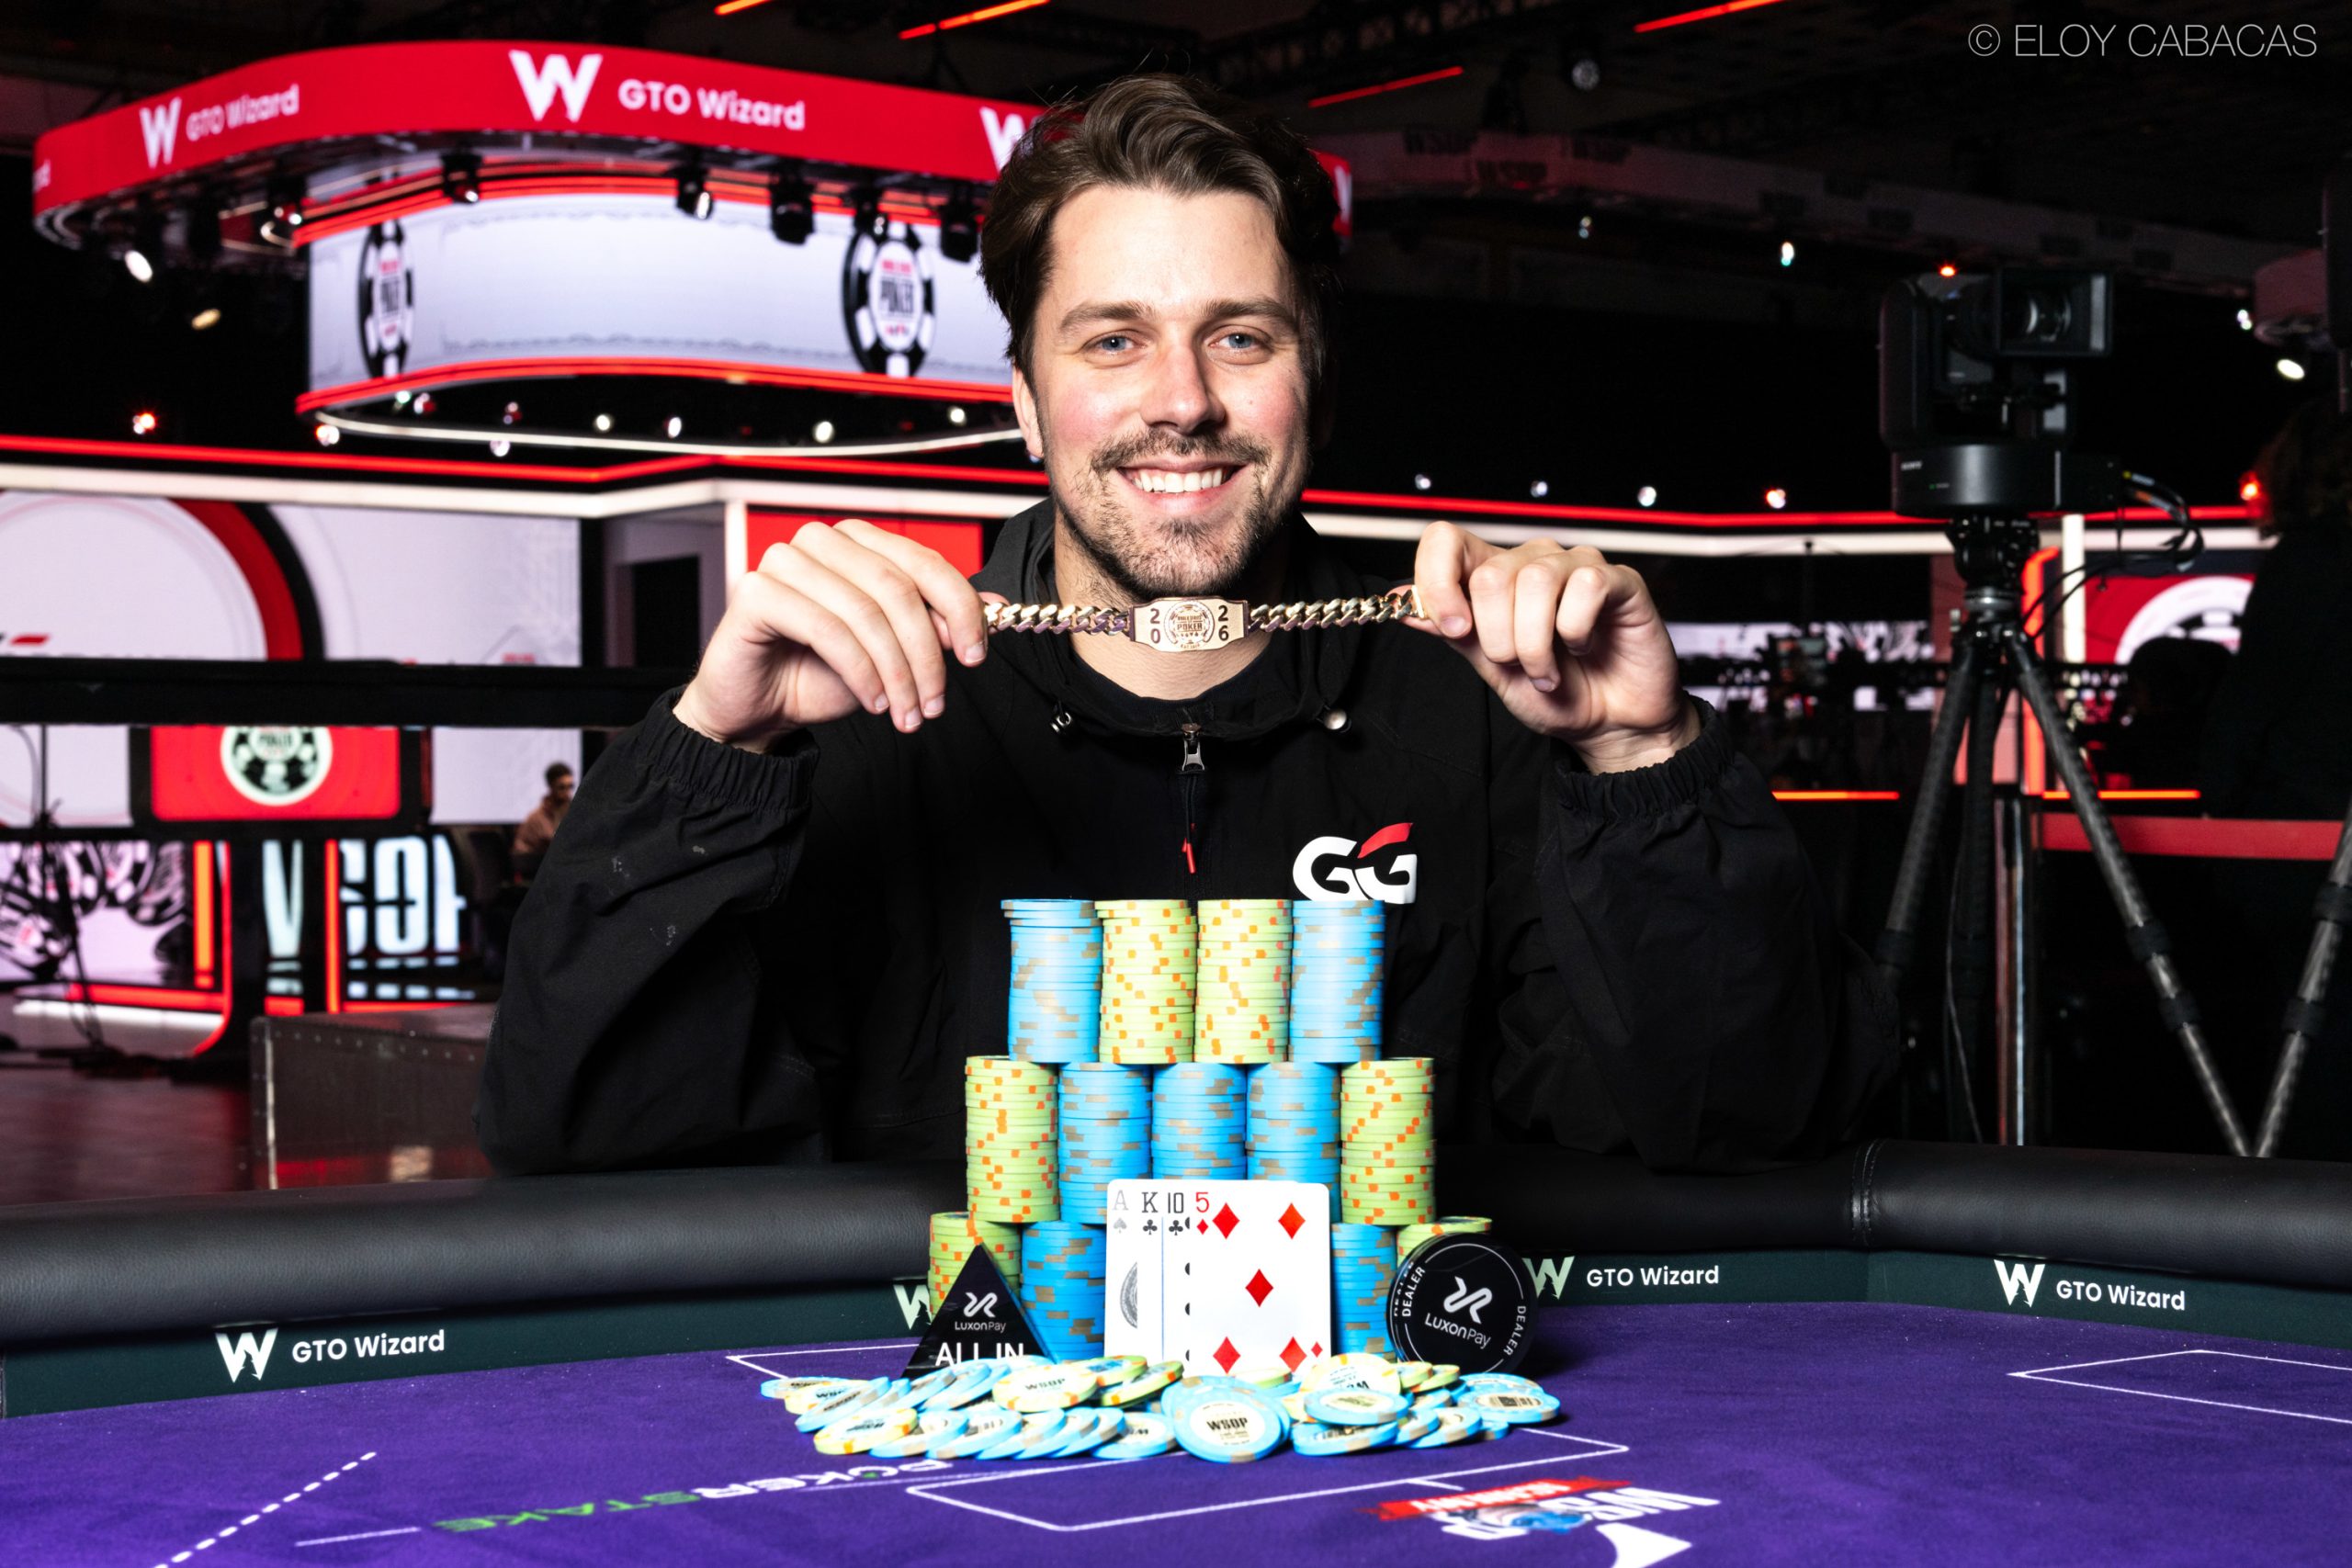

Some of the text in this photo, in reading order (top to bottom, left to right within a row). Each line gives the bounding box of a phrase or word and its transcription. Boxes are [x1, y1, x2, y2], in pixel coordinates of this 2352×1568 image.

[509, 50, 805, 130] W GTO Wizard
[140, 84, 299, 170] W GTO Wizard
[1293, 822, 1418, 904] GG
[1113, 1190, 1210, 1213] A K 10 5
[1402, 1267, 1426, 1317] DEALER
[1521, 1256, 1719, 1300] W GTO Wizard
[1994, 1259, 2186, 1310] W GTO Wizard
[215, 1327, 445, 1382] W GTO Wizard
[996, 1342, 1023, 1360] IN
[1503, 1305, 1527, 1356] DEALER
[1206, 1417, 1248, 1431] WSOP
[1430, 1487, 1722, 1541] WSP
